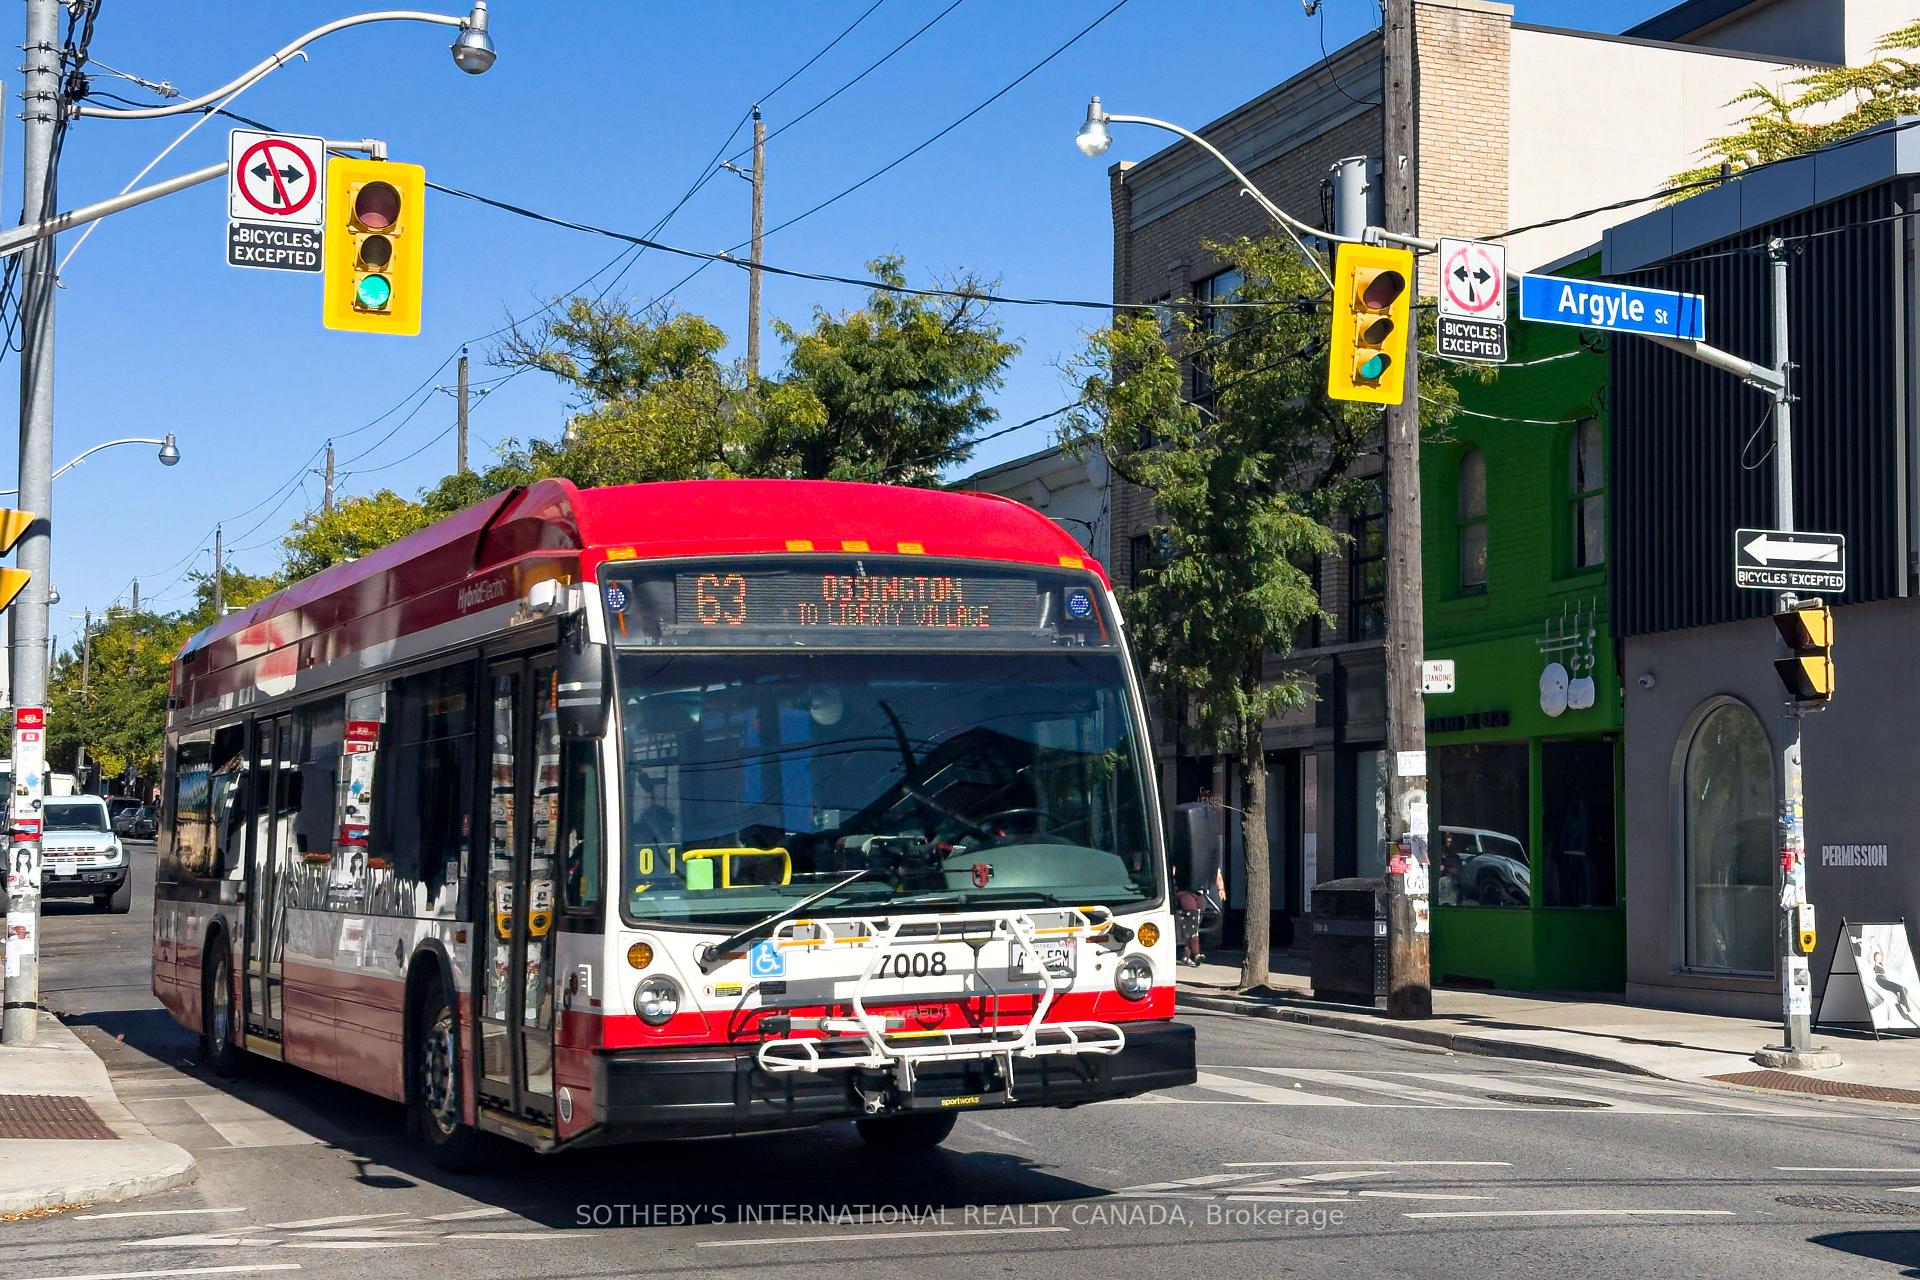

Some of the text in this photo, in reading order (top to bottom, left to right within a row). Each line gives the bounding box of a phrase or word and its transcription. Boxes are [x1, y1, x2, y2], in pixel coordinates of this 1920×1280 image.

[239, 228, 312, 248] BICYCLES
[234, 246, 316, 266] EXCEPTED
[1558, 284, 1669, 326] Argyle St
[1445, 322, 1498, 340] BICYCLES
[1442, 337, 1501, 356] EXCEPTED
[822, 574, 963, 603] OSSINGTON
[1738, 570, 1843, 587] BICYCLES EXCEPTED
[697, 573, 747, 625] 63
[798, 603, 990, 628] TO LIBERTY VILLAGE
[1424, 674, 1453, 682] STANDING
[1433, 664, 1443, 672] NO
[1821, 844, 1888, 867] PERMISSION
[878, 951, 947, 979] 7008
